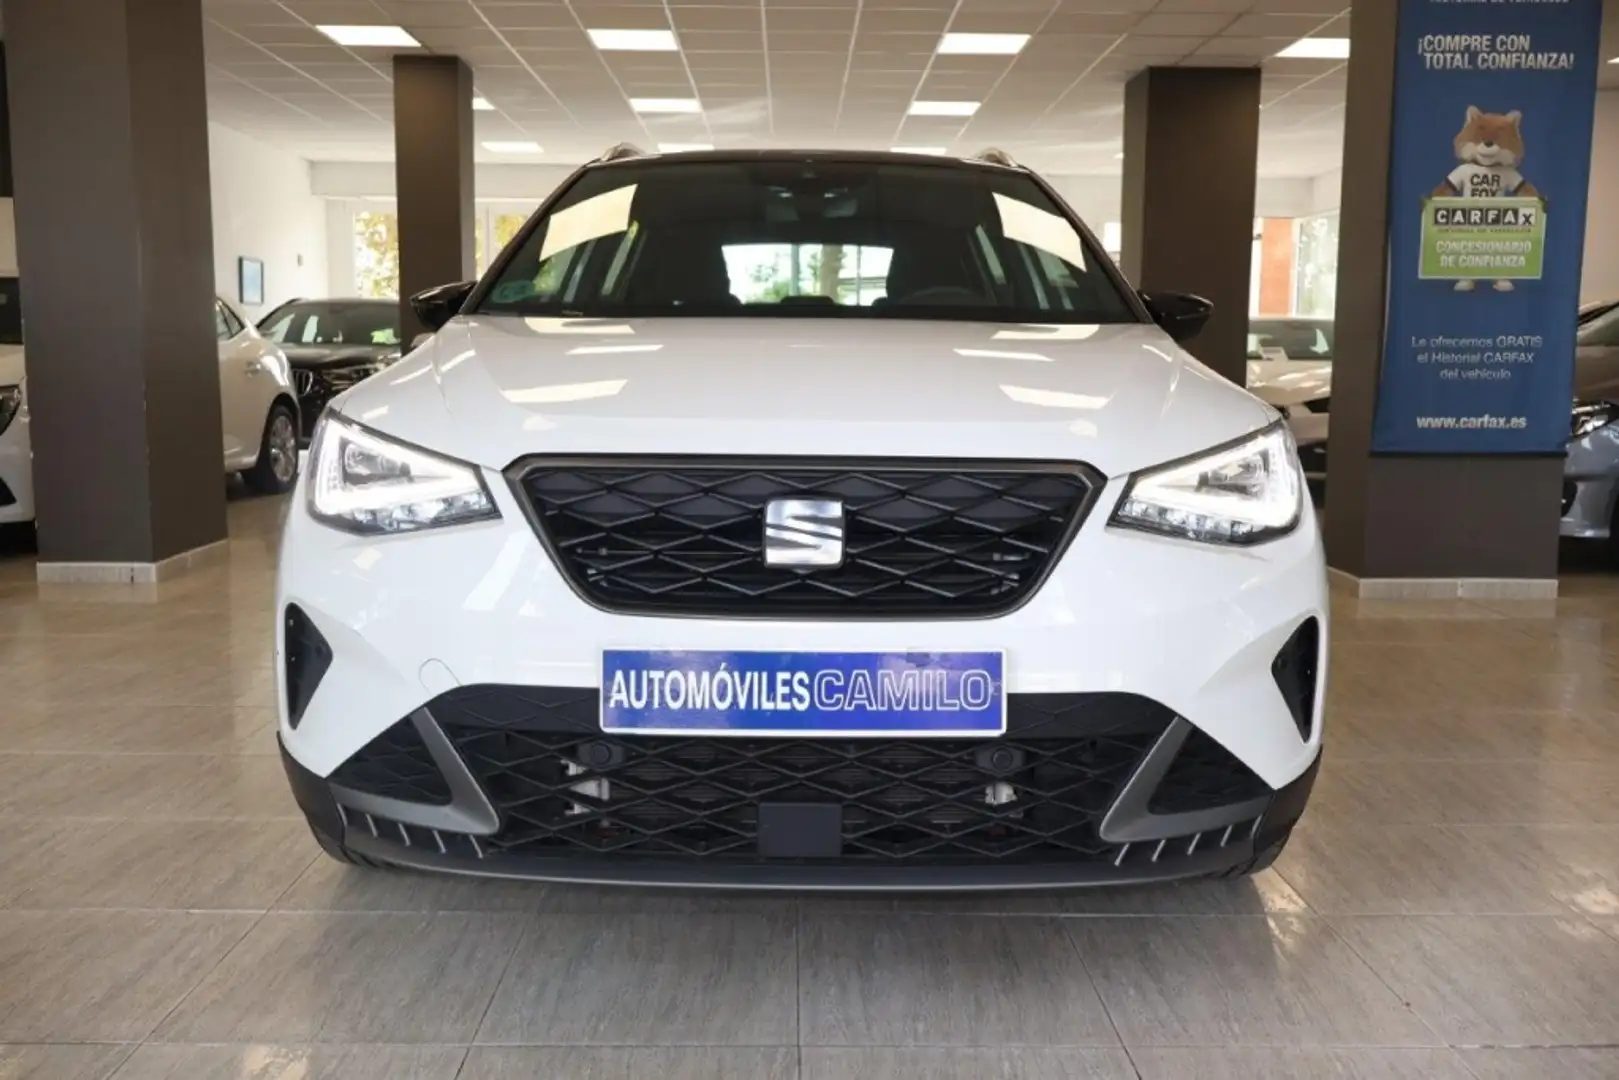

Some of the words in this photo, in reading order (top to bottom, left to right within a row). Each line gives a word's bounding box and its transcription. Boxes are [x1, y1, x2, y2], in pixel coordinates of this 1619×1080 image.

[1418, 35, 1492, 54] ¡COMPRE
[1496, 35, 1531, 51] CON
[1424, 53, 1473, 69] TOTAL
[1477, 53, 1575, 69] CONFIANZA!
[1470, 173, 1501, 187] CAR
[1470, 187, 1500, 197] FOX
[1435, 207, 1535, 225] CARFAX
[1436, 240, 1532, 253] CONCESIONARIO
[1441, 255, 1455, 267] DE
[1458, 255, 1526, 268] CONFIANZA
[1411, 336, 1427, 347] Le
[1430, 335, 1493, 348] ofrecemos
[1496, 335, 1543, 347] GRATIS
[1417, 352, 1428, 363] el
[1431, 352, 1480, 363] Historial
[1483, 352, 1535, 363] CARFAX
[1440, 368, 1458, 380] del
[1416, 413, 1527, 429] www.carfax.es
[608, 662, 811, 712] AUTOMÓVILES
[813, 669, 992, 711] CAMILO
